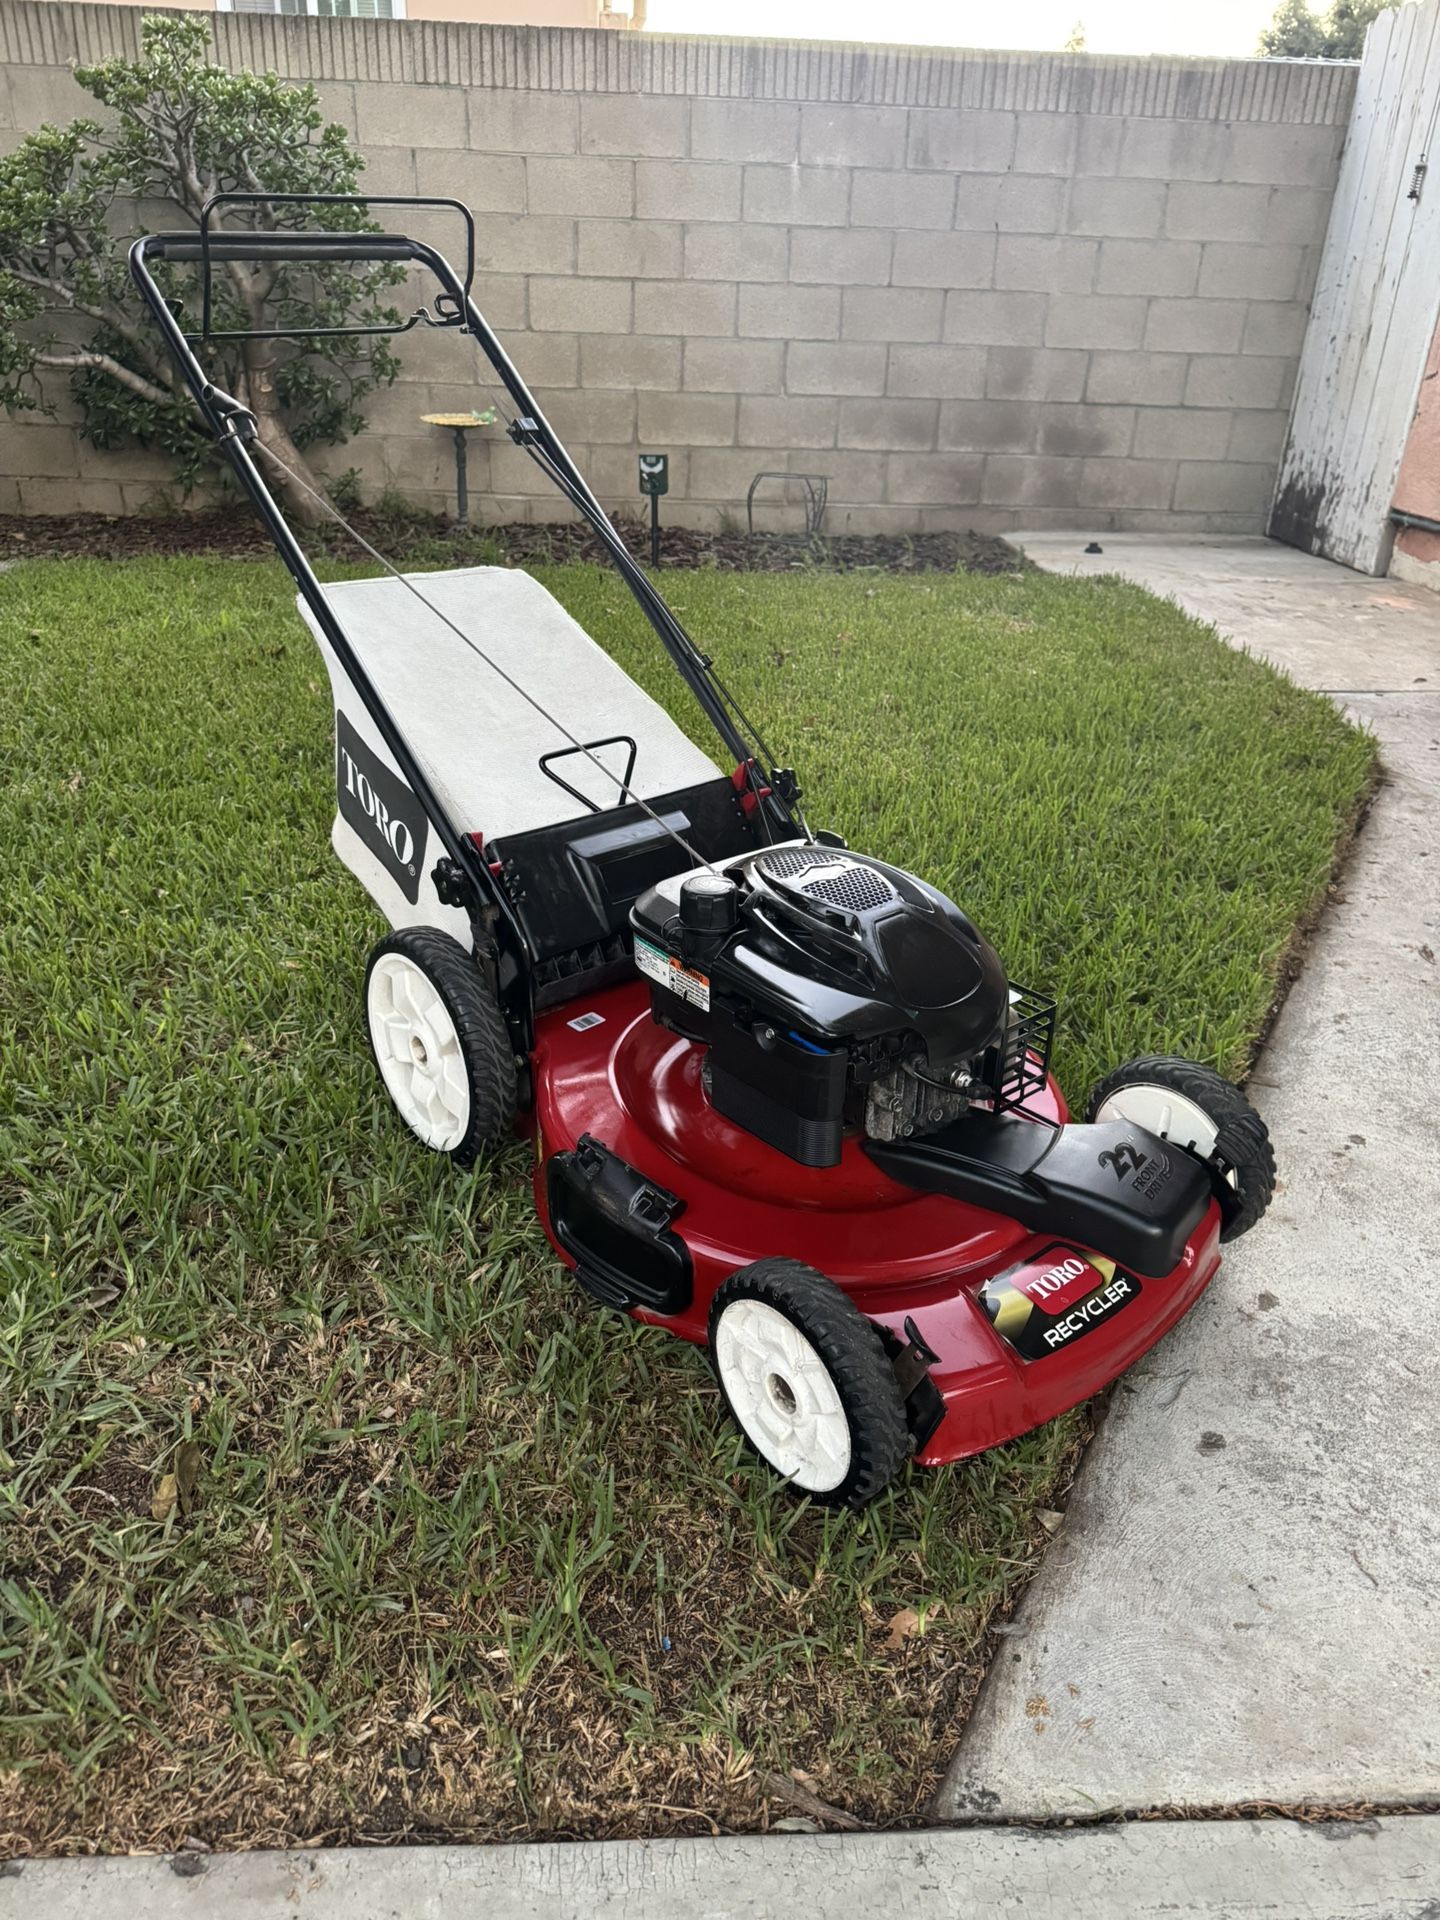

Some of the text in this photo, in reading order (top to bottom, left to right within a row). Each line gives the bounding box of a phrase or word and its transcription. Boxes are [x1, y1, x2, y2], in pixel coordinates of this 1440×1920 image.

[341, 746, 414, 865] TORO
[1131, 1158, 1160, 1192] FRONT
[1144, 1169, 1171, 1201] DRIVE
[1026, 1258, 1083, 1299] TORO
[1043, 1281, 1132, 1347] RECYCLER
